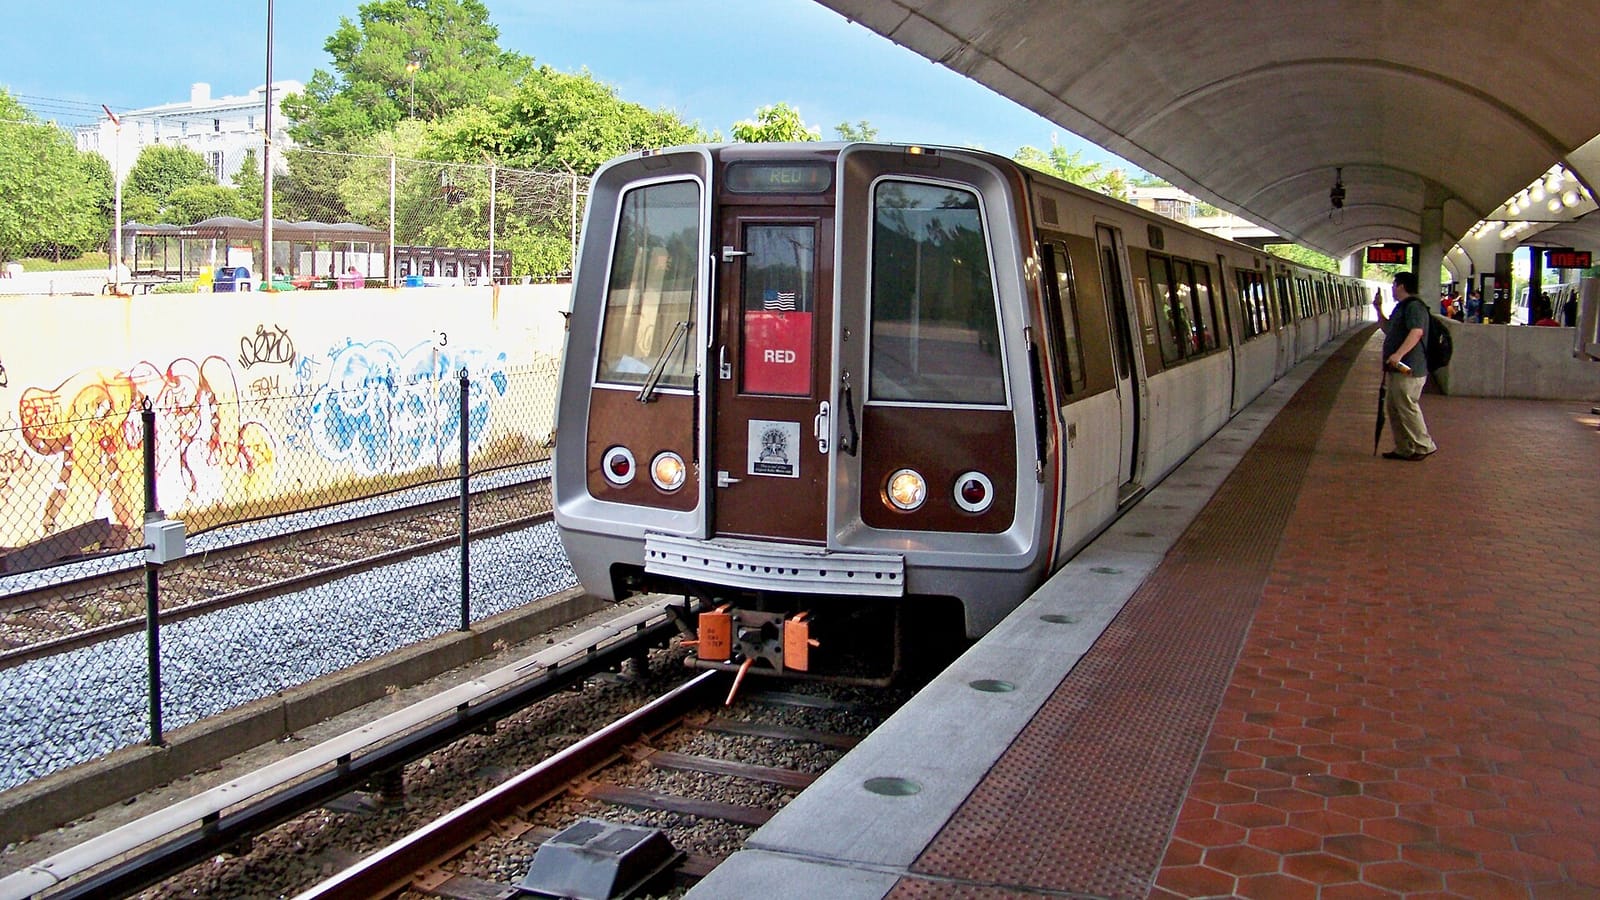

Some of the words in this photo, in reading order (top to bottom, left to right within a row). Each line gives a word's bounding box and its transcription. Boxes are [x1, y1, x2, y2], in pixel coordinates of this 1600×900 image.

[770, 167, 802, 184] RED
[438, 332, 449, 347] 3
[764, 349, 796, 364] RED
